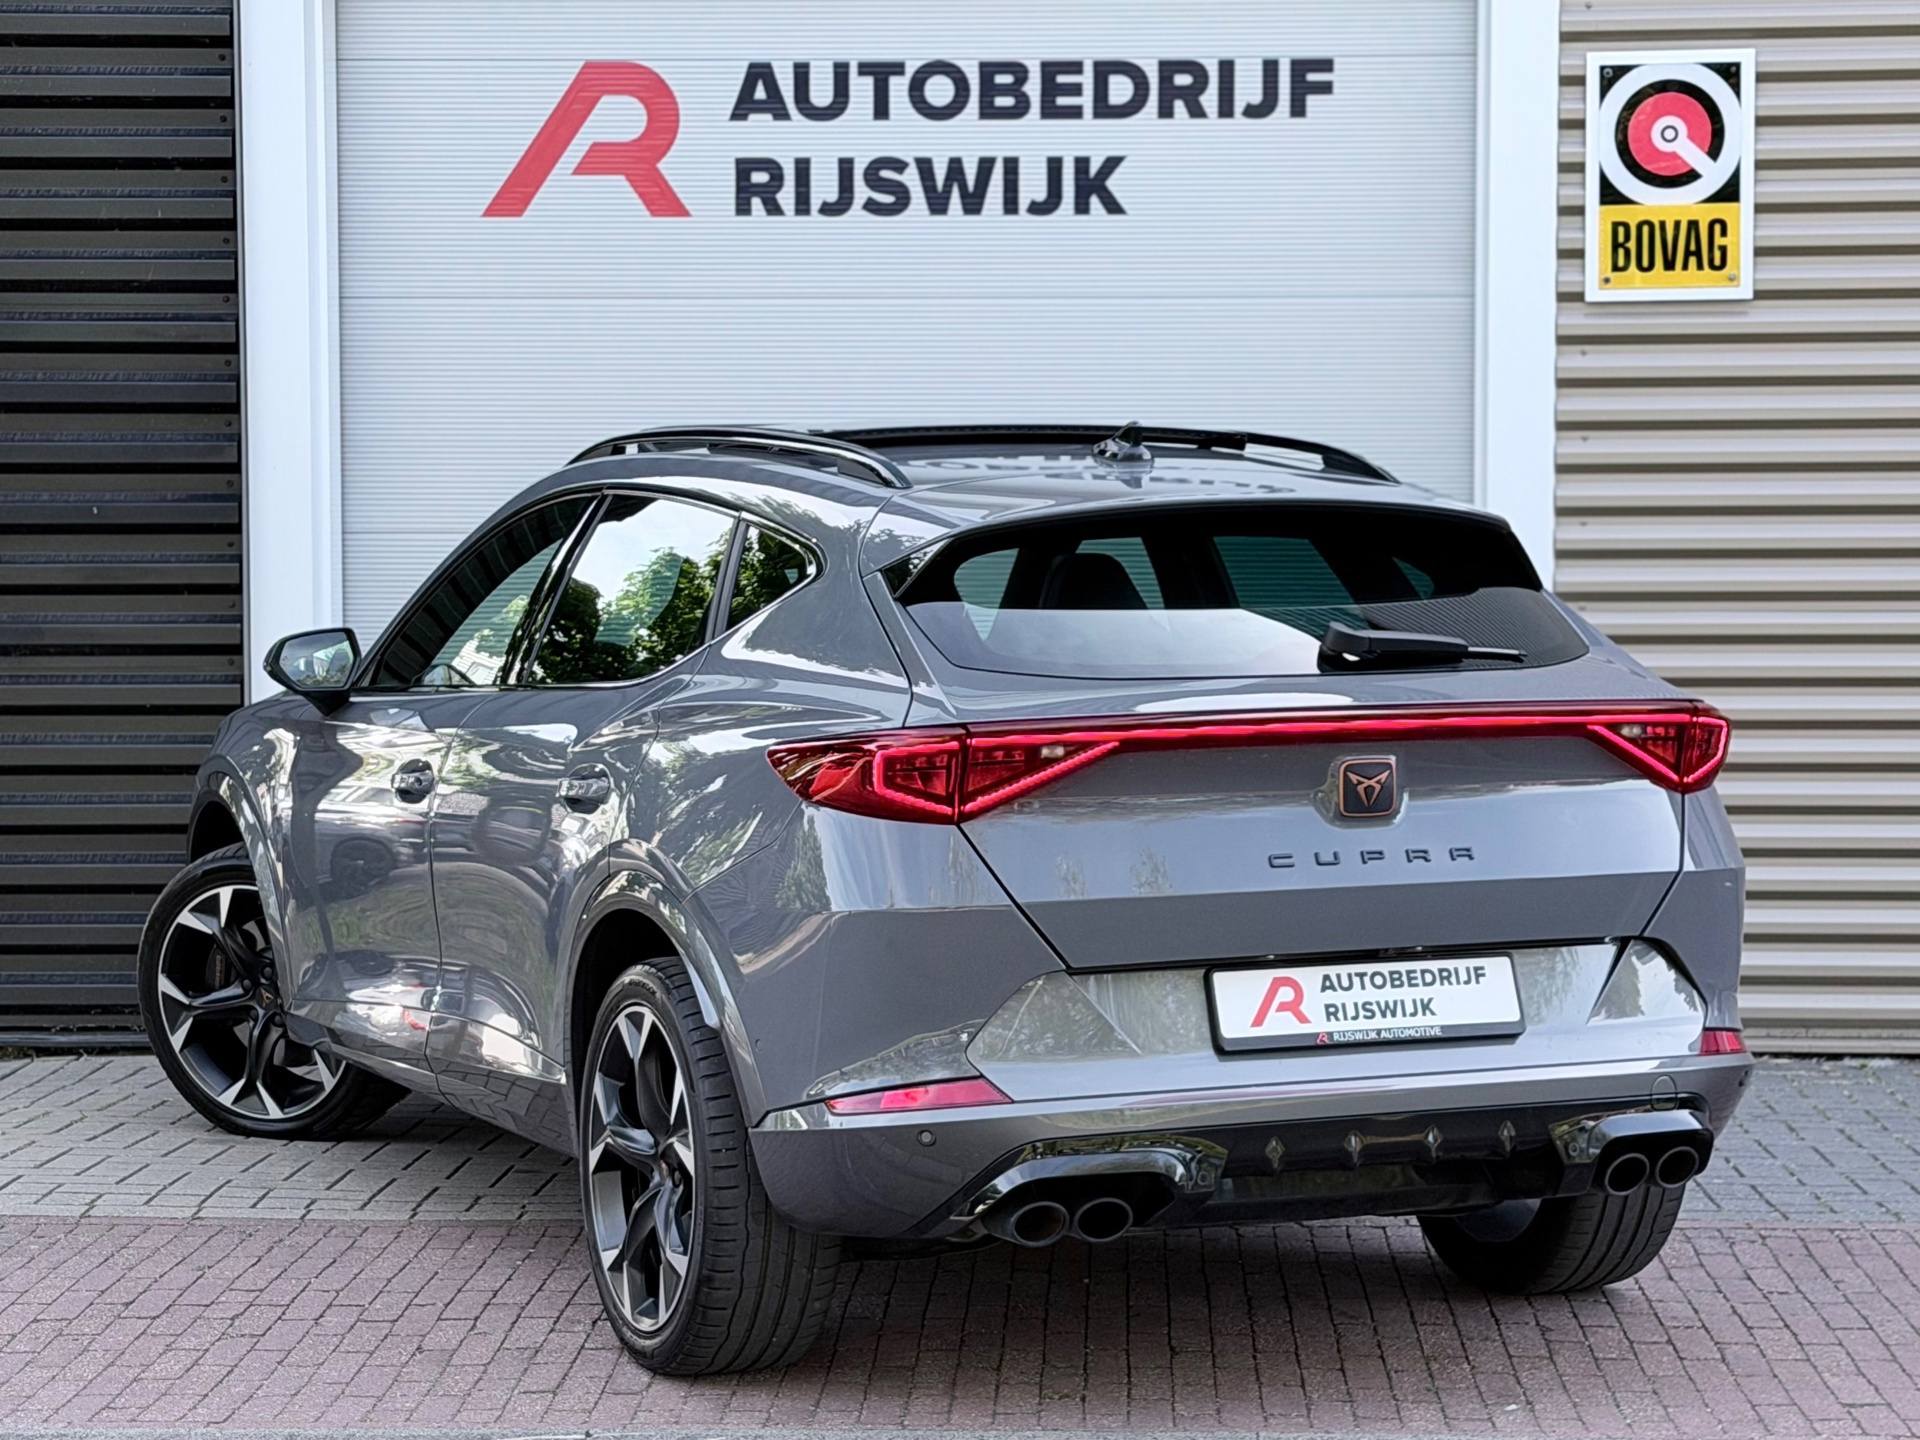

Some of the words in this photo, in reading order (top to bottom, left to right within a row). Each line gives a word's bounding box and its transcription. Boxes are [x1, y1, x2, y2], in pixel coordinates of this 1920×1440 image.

[729, 57, 1335, 122] AUTOBEDRIJF
[734, 156, 1128, 217] RIJSWIJK
[1611, 218, 1728, 273] BOVAG
[1268, 847, 1475, 868] CUPRA
[1320, 966, 1486, 992] AUTOBEDRIJF
[1323, 997, 1438, 1022] RIJSWIJK
[1333, 1030, 1379, 1042] RIJSWIJK
[1380, 1026, 1442, 1039] AUTOMOTIVE
